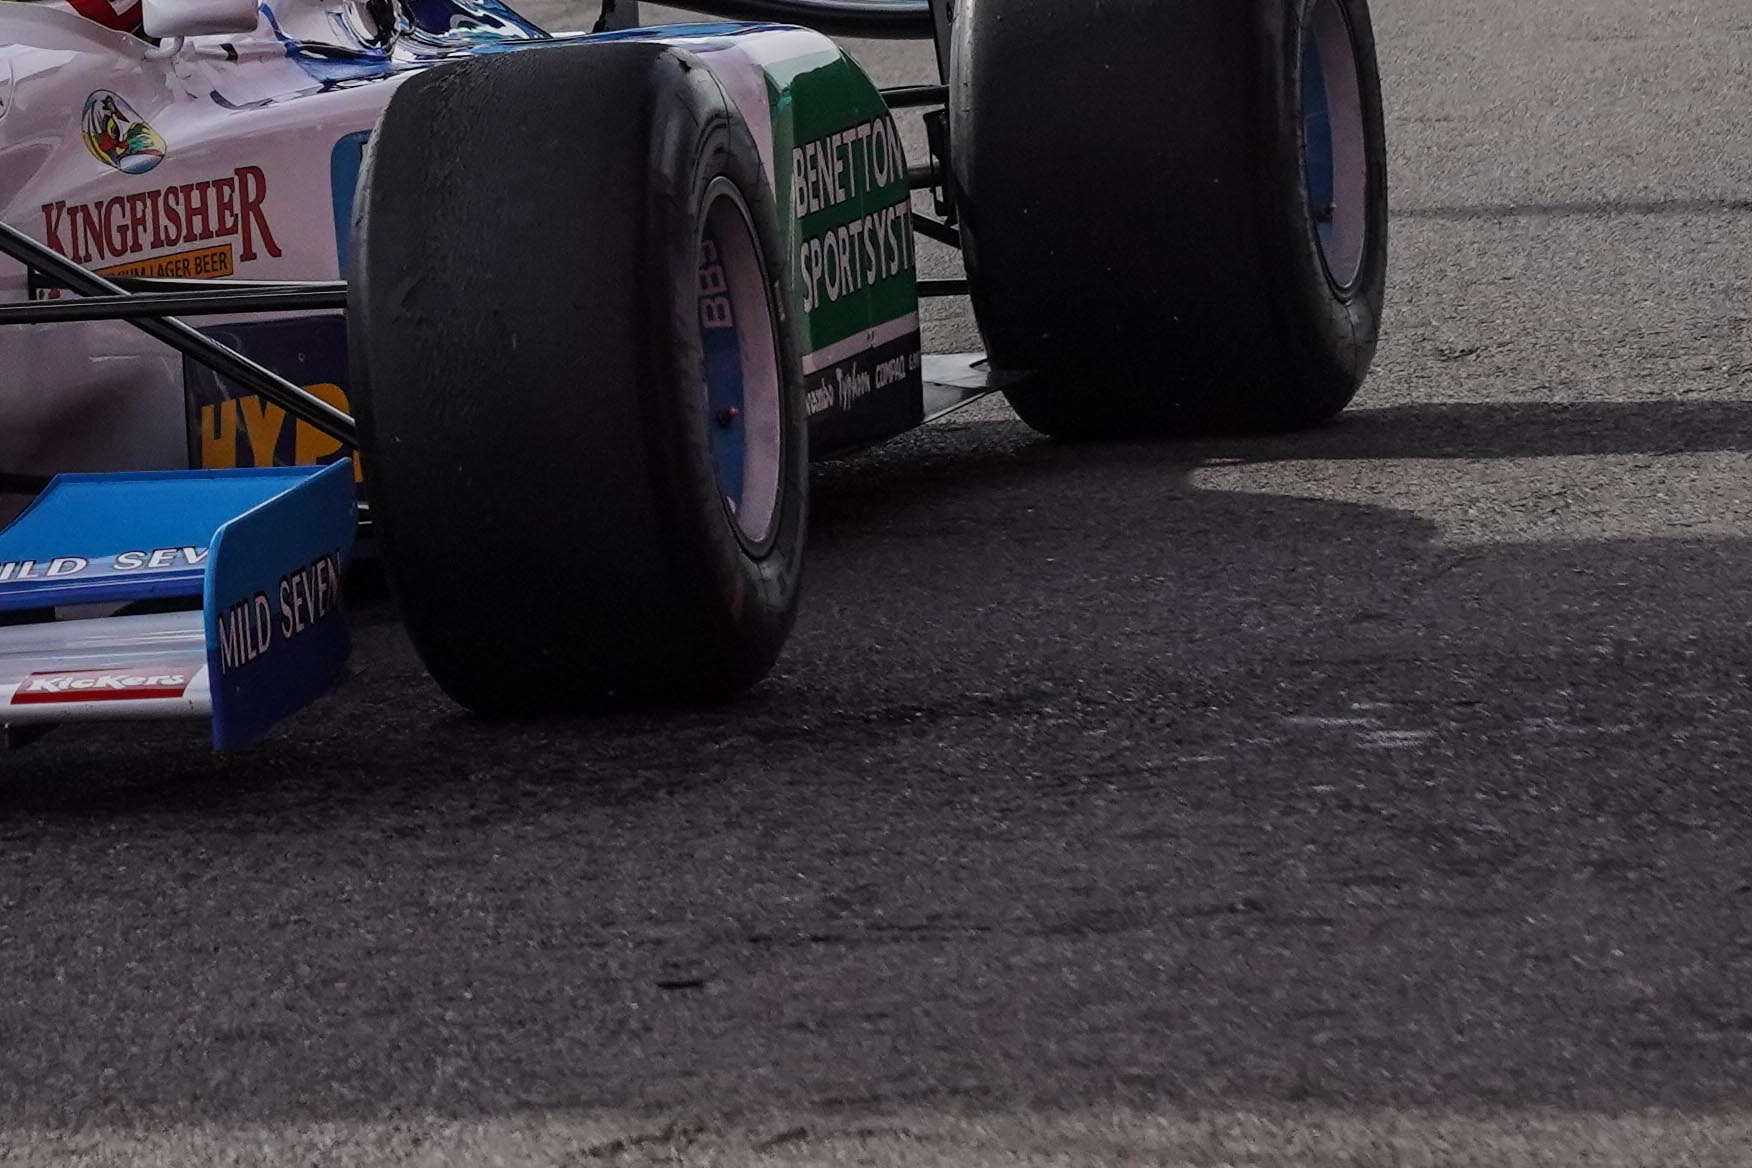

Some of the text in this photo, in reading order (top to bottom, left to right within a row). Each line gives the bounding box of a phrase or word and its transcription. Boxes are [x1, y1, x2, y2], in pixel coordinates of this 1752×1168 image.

[41, 165, 282, 264] KINGFISHER
[791, 115, 904, 220] BENETTON
[194, 251, 229, 274] BEER
[201, 383, 363, 483] HYP
[217, 550, 344, 675] MILD SEVEN
